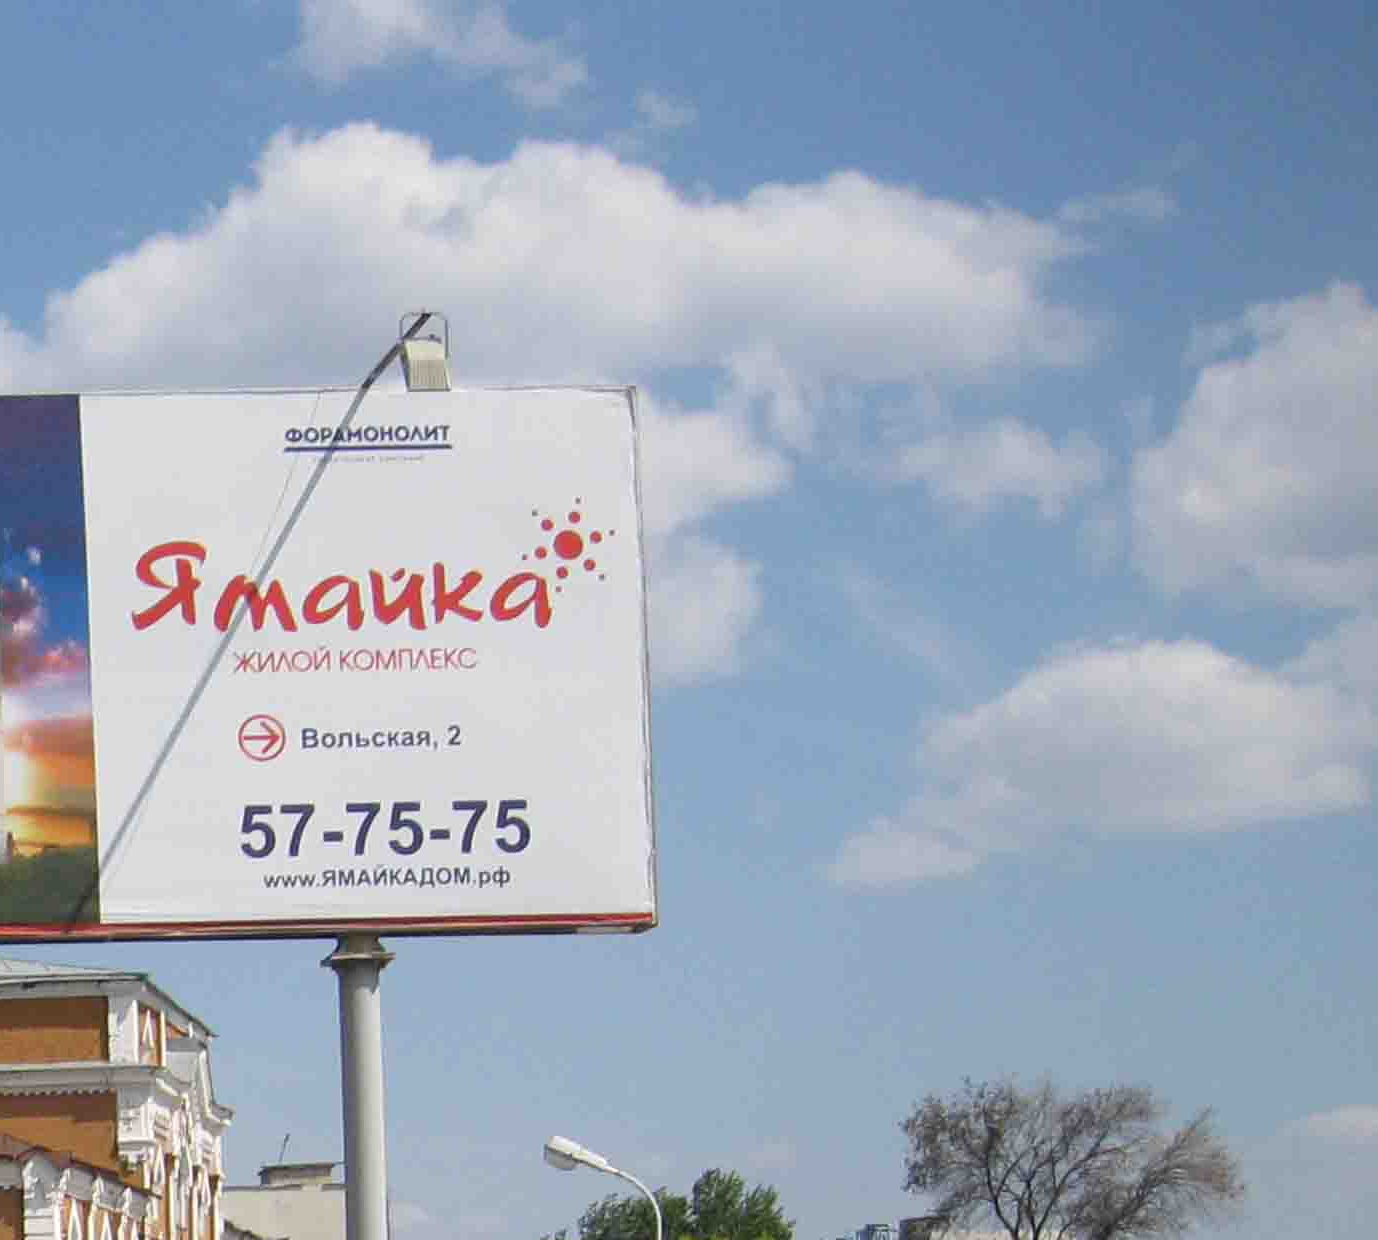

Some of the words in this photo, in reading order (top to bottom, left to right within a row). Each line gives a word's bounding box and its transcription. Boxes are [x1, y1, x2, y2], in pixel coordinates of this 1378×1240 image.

[284, 425, 451, 443] ФОРАМОНОЛИТ
[131, 540, 552, 633] Ямайка
[233, 647, 331, 674] ЖИЛОЙ
[339, 647, 479, 671] КОМПЛЕКС
[300, 727, 440, 751] Вольская,
[448, 725, 462, 747] 2
[240, 799, 532, 858] 57-75-75
[263, 864, 511, 888] www.ЯМАЙКАДОМ.рф
